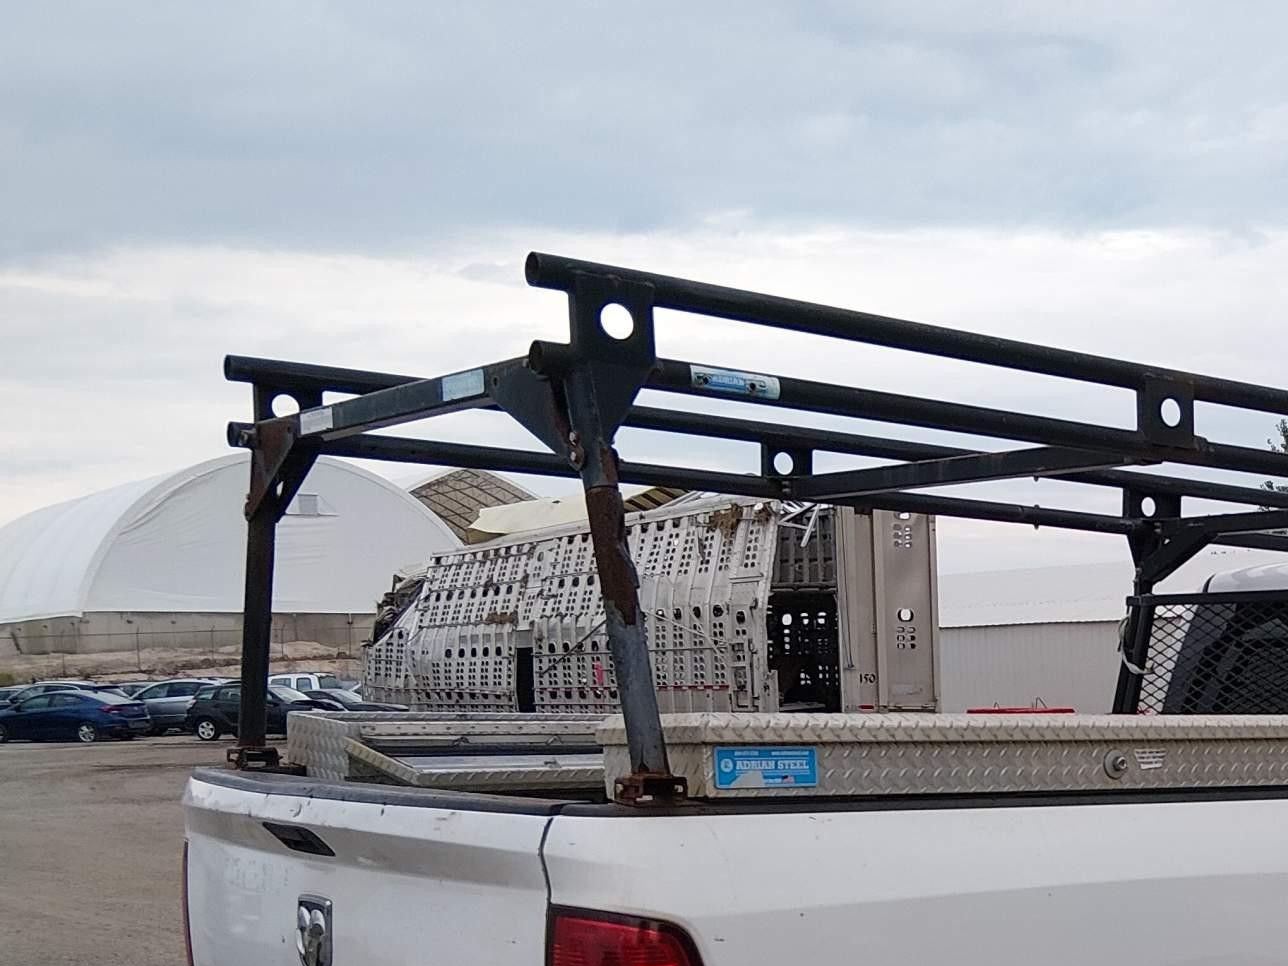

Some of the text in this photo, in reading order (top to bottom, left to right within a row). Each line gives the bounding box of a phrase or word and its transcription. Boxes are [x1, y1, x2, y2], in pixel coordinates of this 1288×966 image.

[859, 673, 876, 684] 150
[736, 760, 809, 770] ADRIAN STEEL
